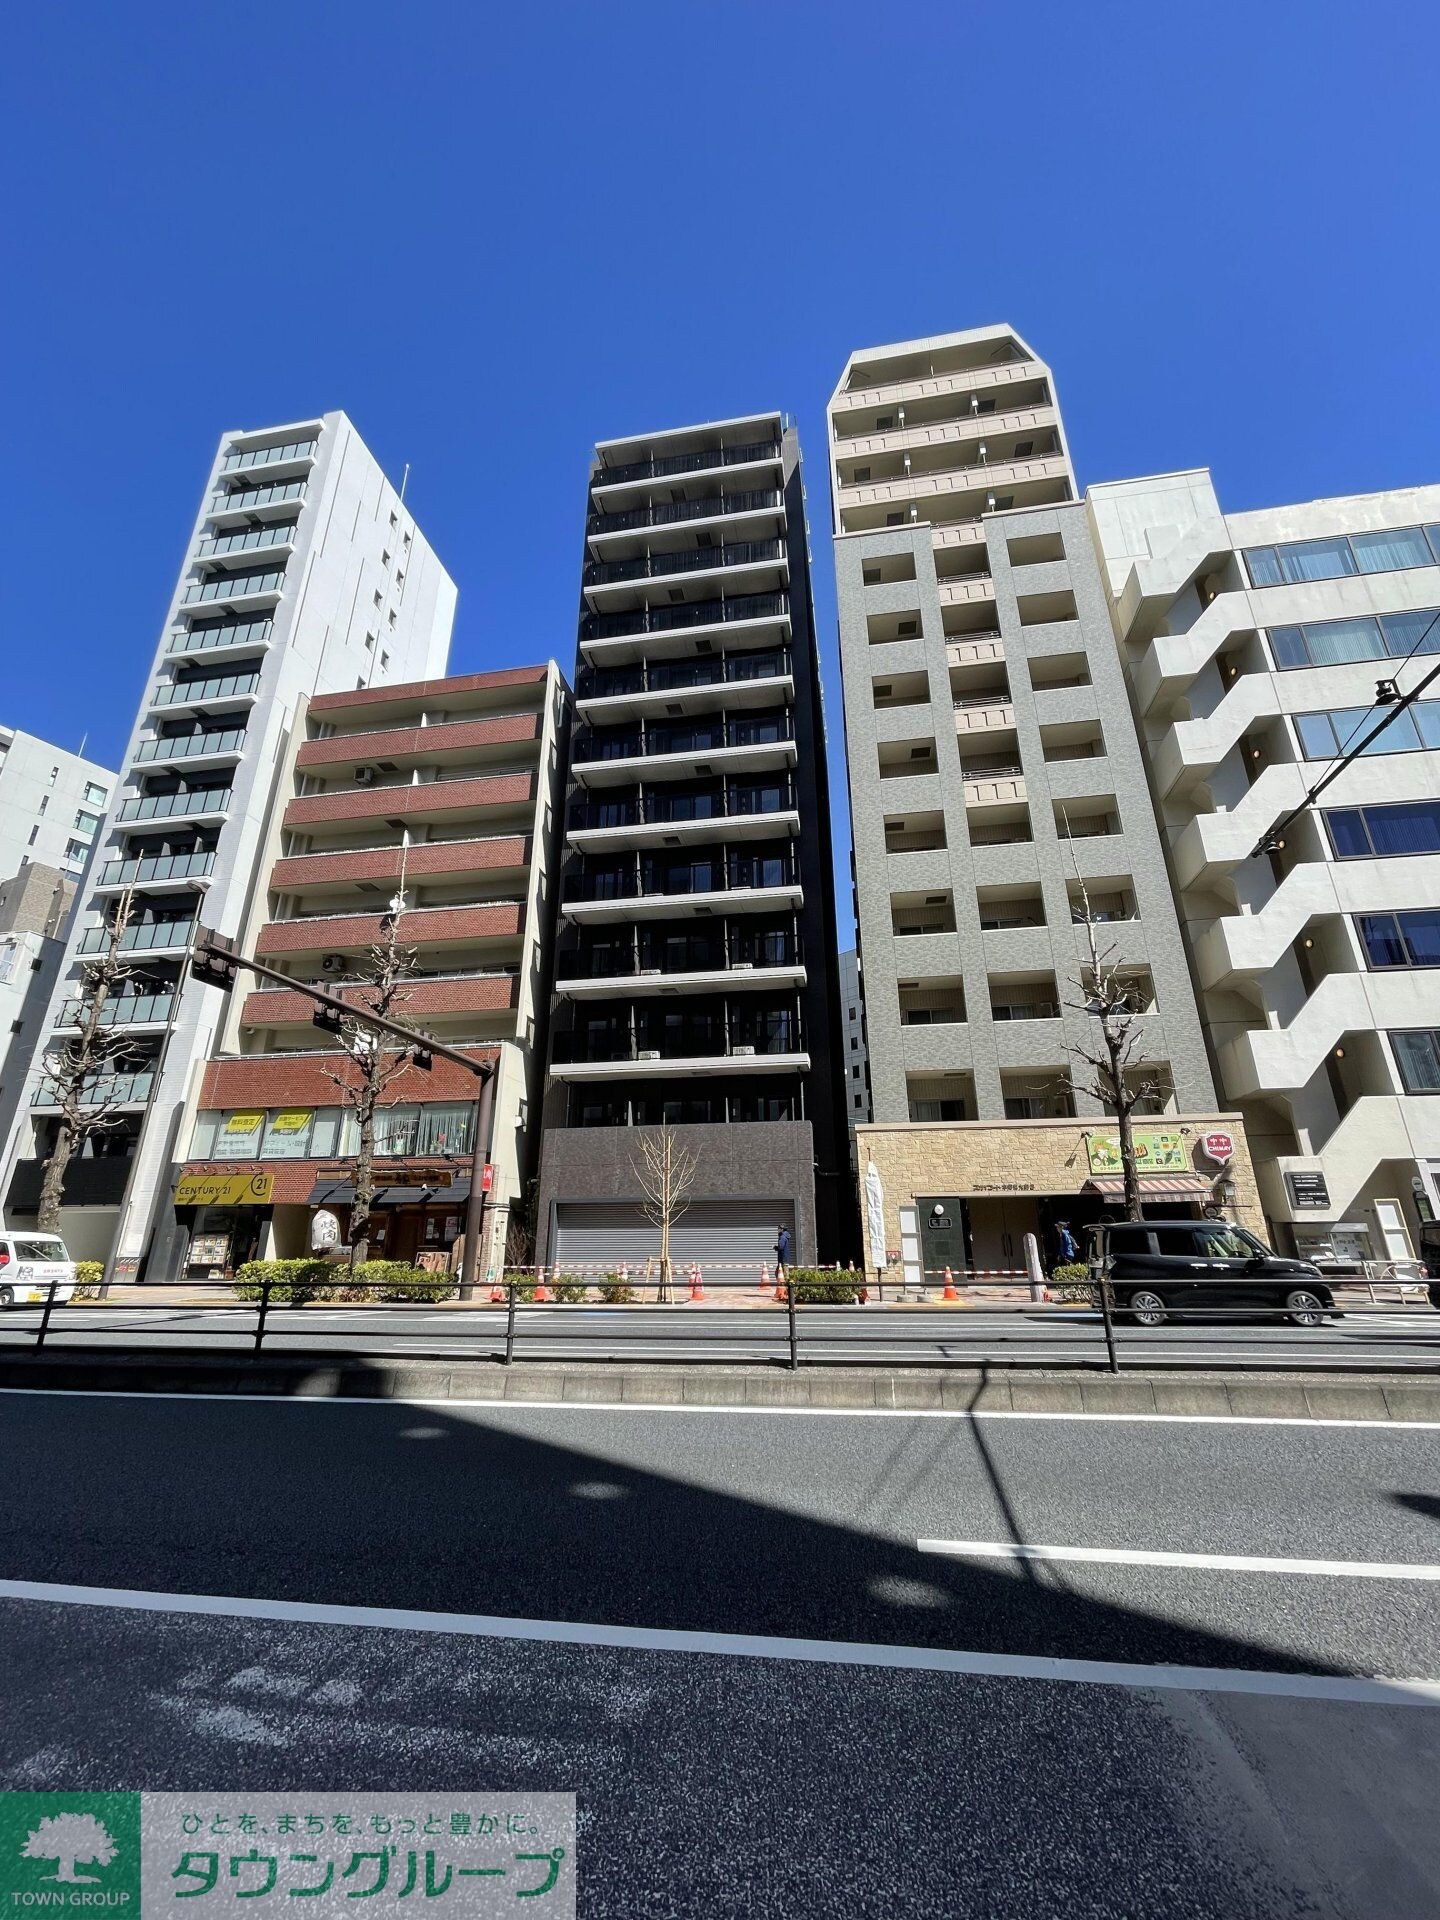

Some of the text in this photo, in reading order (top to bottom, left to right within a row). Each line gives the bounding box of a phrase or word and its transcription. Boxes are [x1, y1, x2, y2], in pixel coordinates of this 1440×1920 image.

[256, 1178, 268, 1190] 21
[179, 1186, 231, 1195] CENTURY 21
